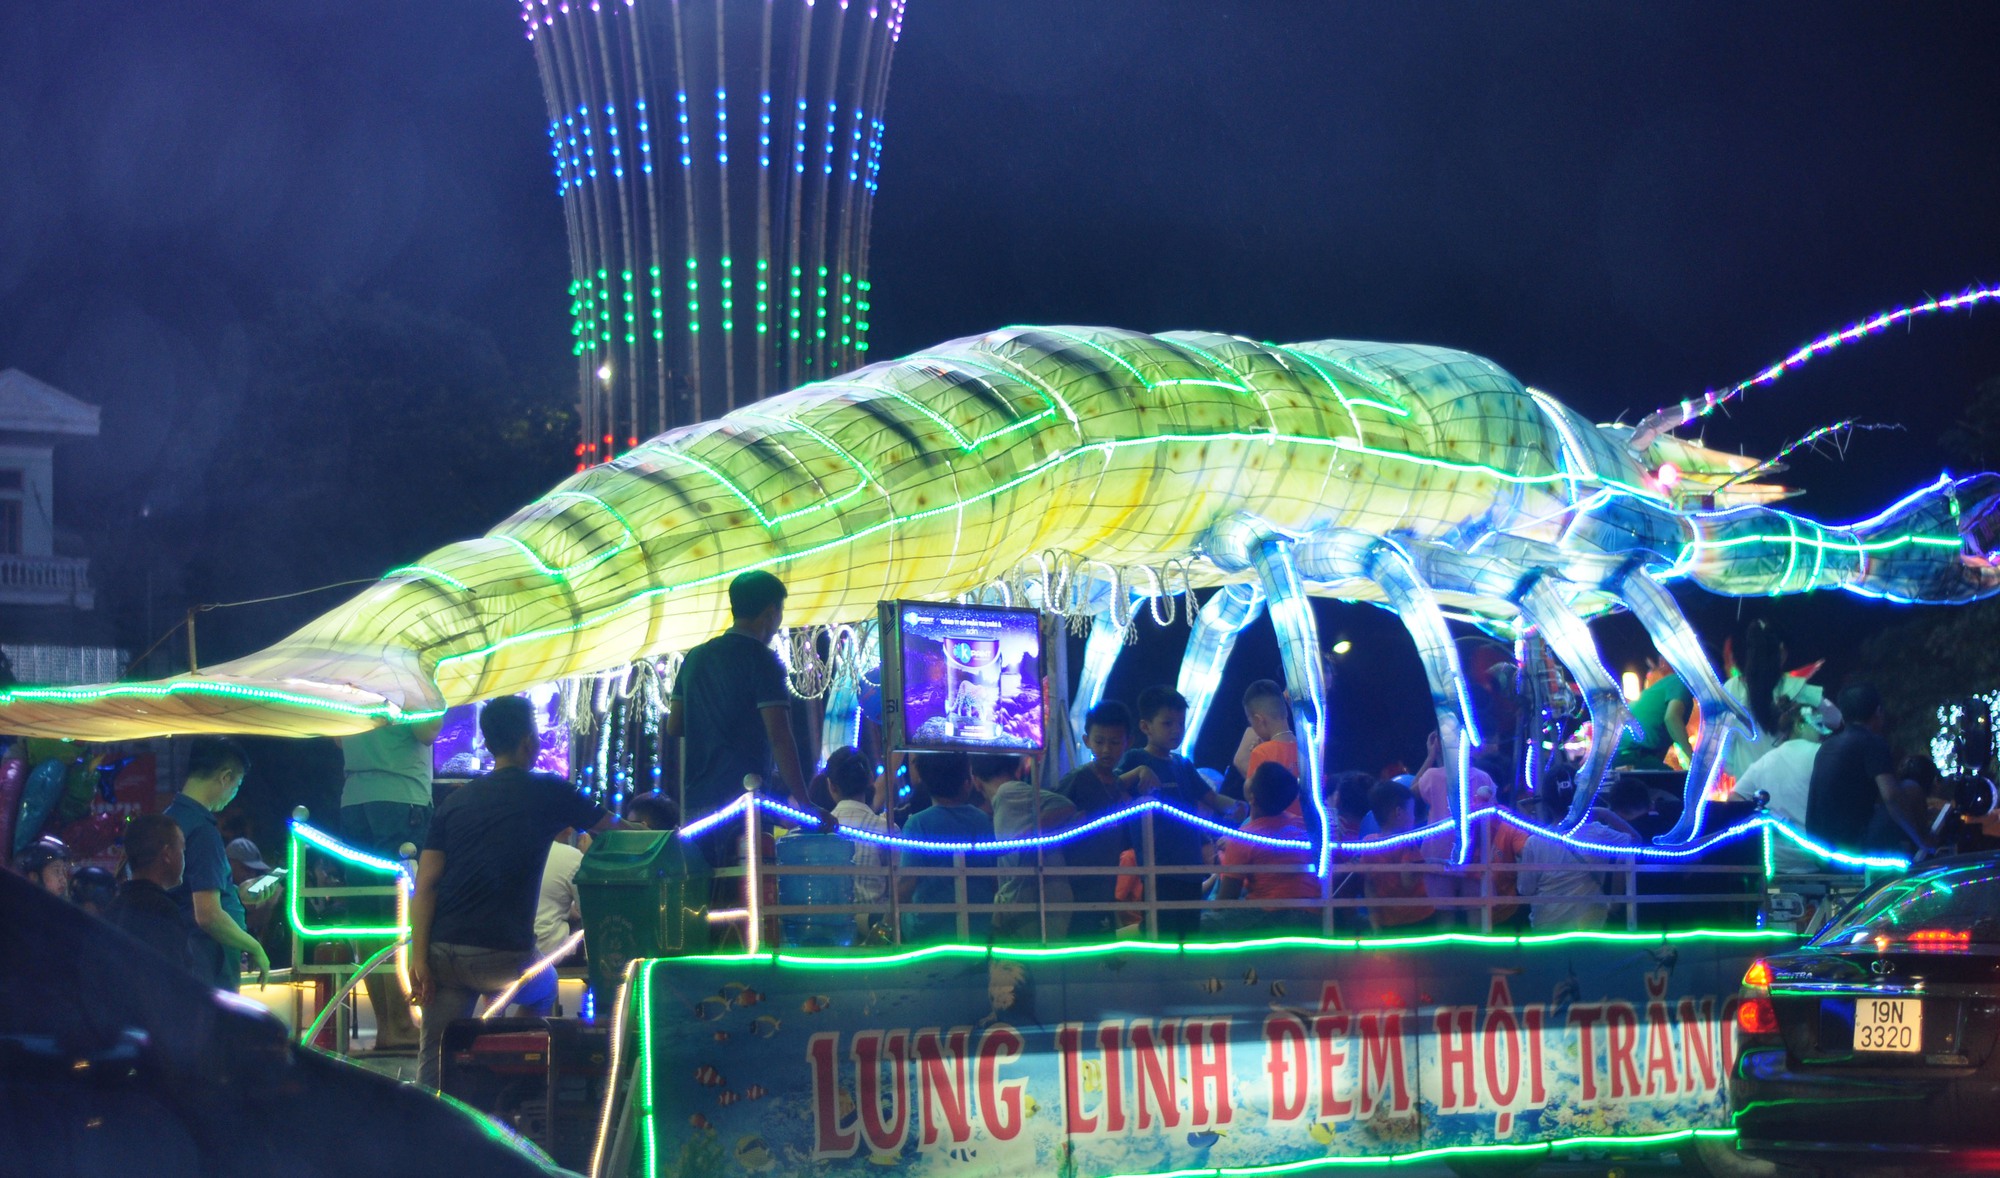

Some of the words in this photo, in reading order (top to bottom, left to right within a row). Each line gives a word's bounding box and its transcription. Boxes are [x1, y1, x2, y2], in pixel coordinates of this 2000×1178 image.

[1872, 1001, 1904, 1024] 19N
[1860, 1025, 1912, 1049] 3320
[808, 1022, 1028, 1160] LUNG
[1056, 1016, 1233, 1134] LINH
[1262, 980, 1418, 1126] ĐÊM
[1434, 973, 1546, 1138] HỘI
